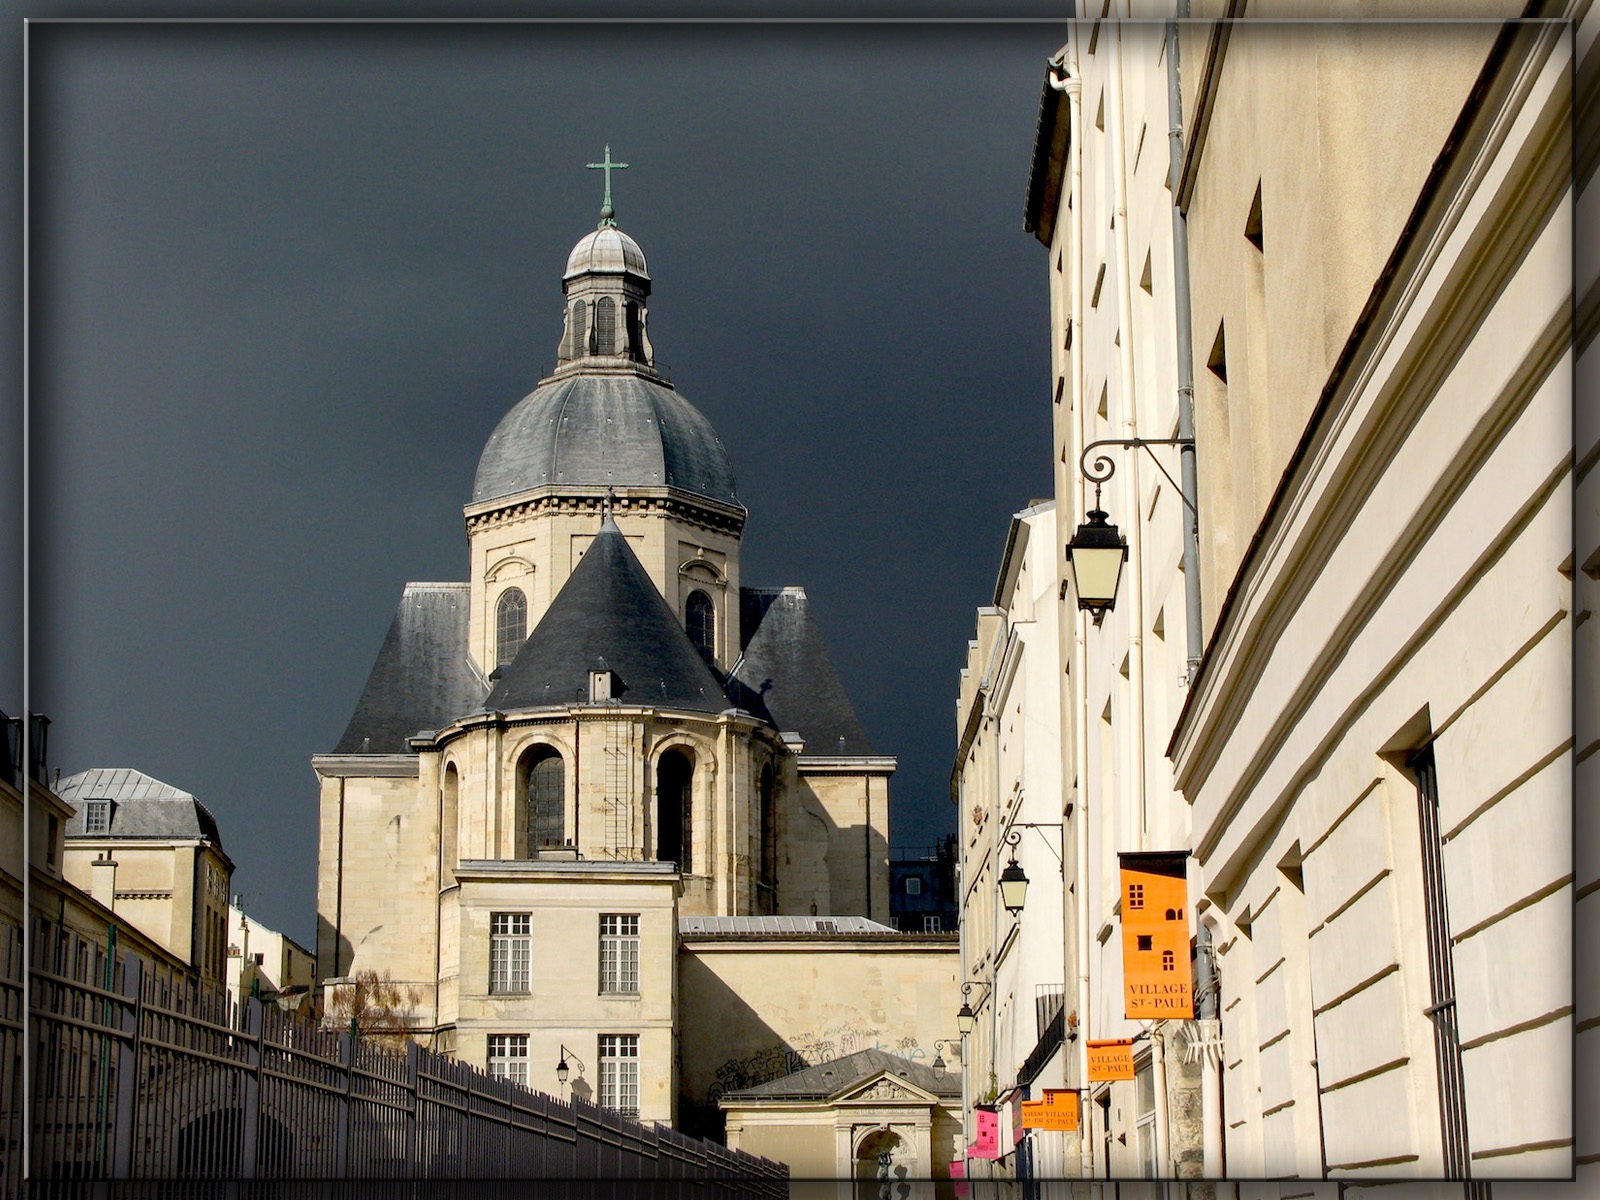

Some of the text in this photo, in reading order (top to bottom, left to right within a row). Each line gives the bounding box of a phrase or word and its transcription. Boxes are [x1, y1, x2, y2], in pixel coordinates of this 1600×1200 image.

[1130, 983, 1188, 994] VILLAGE
[1131, 998, 1189, 1008] ST-PAUL
[1090, 1055, 1130, 1064] VILLAGE
